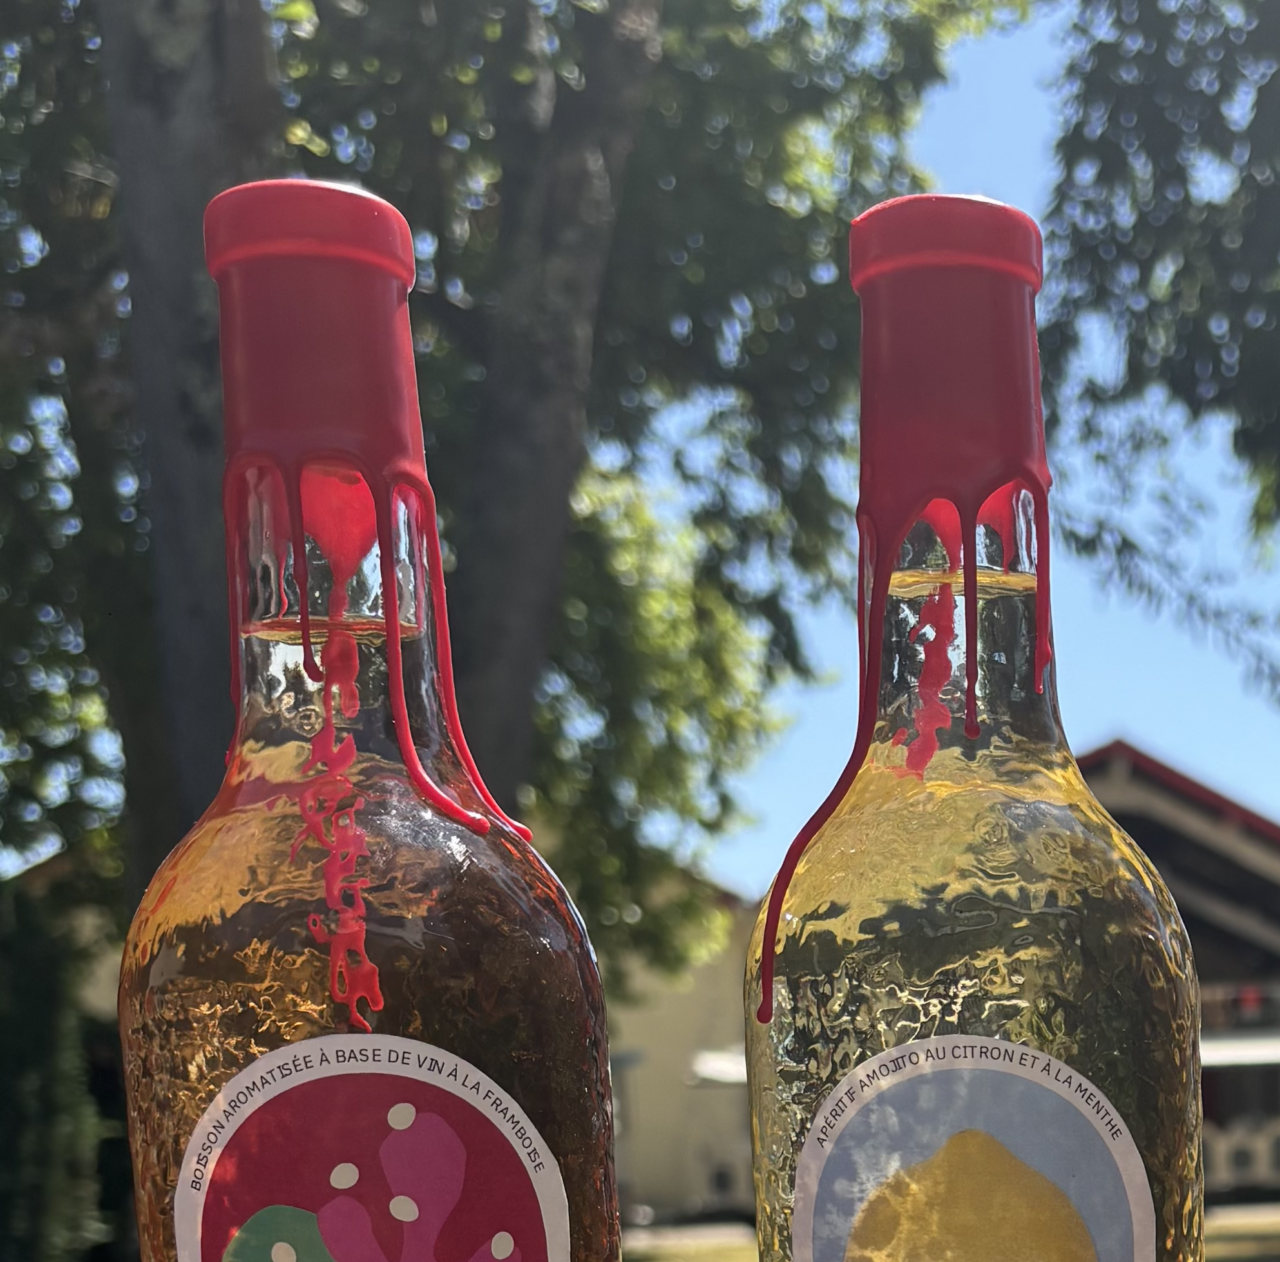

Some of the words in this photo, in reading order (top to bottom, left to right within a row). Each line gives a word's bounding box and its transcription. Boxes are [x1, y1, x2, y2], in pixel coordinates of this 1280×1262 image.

[190, 1120, 226, 1192] BOISSON
[223, 1053, 315, 1122] AROMATISÉE
[319, 1047, 330, 1065] À
[335, 1048, 382, 1064] BASE
[388, 1049, 411, 1065] DE
[416, 1053, 445, 1075] VIN
[446, 1062, 459, 1081] À
[460, 1073, 481, 1096] LA
[482, 1089, 545, 1174] FRAMBOISE
[816, 1085, 856, 1148] APÉRITIF
[859, 1050, 920, 1093] AMOJITO
[925, 1046, 946, 1062] AU
[951, 1045, 1014, 1063] CITRON
[1019, 1052, 1040, 1067] ET
[1040, 1057, 1052, 1075] À
[1054, 1067, 1072, 1089] LA
[1074, 1082, 1123, 1141] MENTHE
